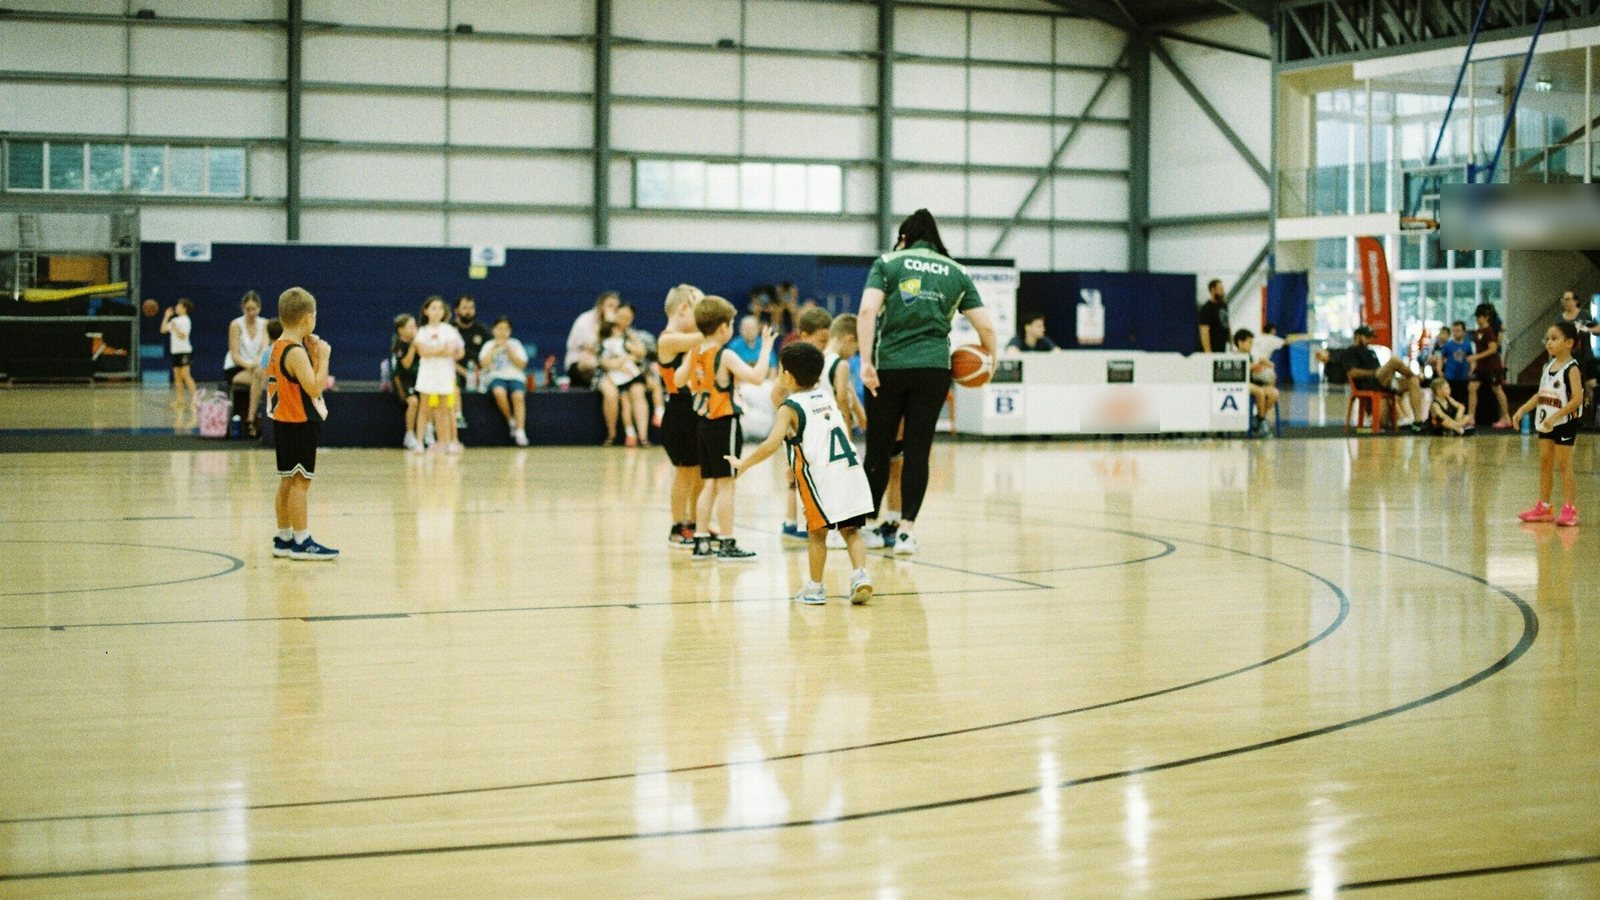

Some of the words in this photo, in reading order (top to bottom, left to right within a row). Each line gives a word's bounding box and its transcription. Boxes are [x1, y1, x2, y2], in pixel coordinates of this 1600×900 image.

[904, 259, 949, 276] COACH
[996, 397, 1014, 414] B
[1220, 395, 1238, 411] A
[829, 426, 859, 468] 4
